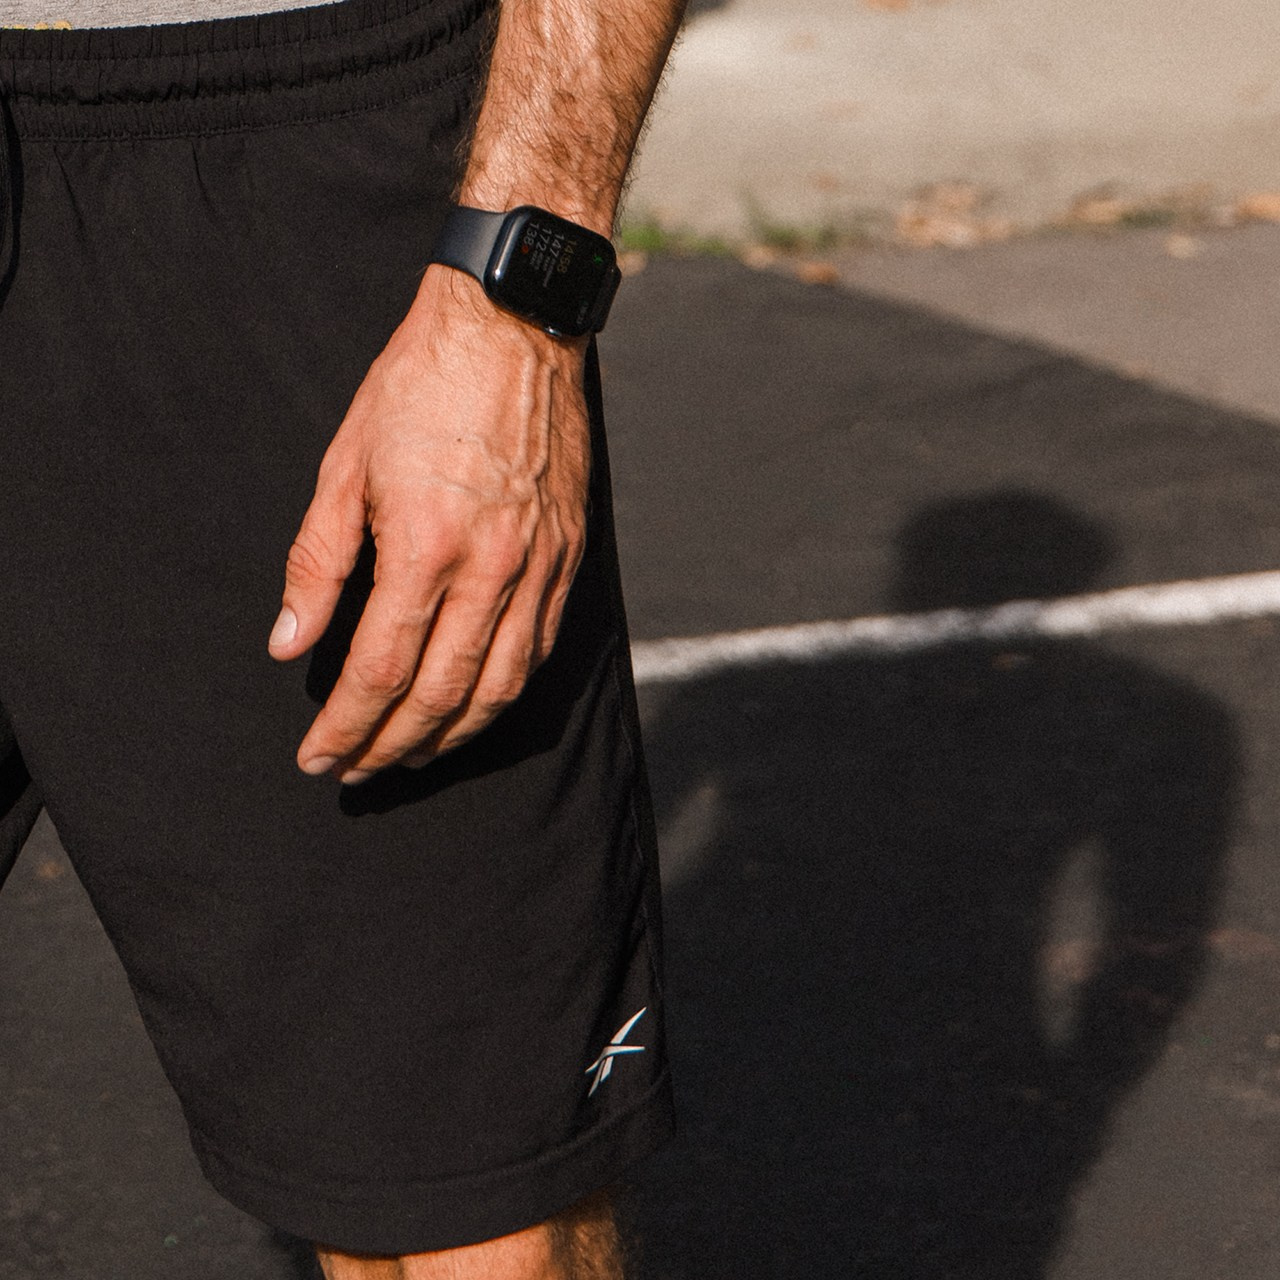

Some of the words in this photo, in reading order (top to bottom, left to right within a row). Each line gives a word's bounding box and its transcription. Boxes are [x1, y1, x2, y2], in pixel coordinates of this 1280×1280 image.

[523, 222, 539, 246] 138
[535, 228, 552, 251] 172
[549, 234, 565, 257] 147
